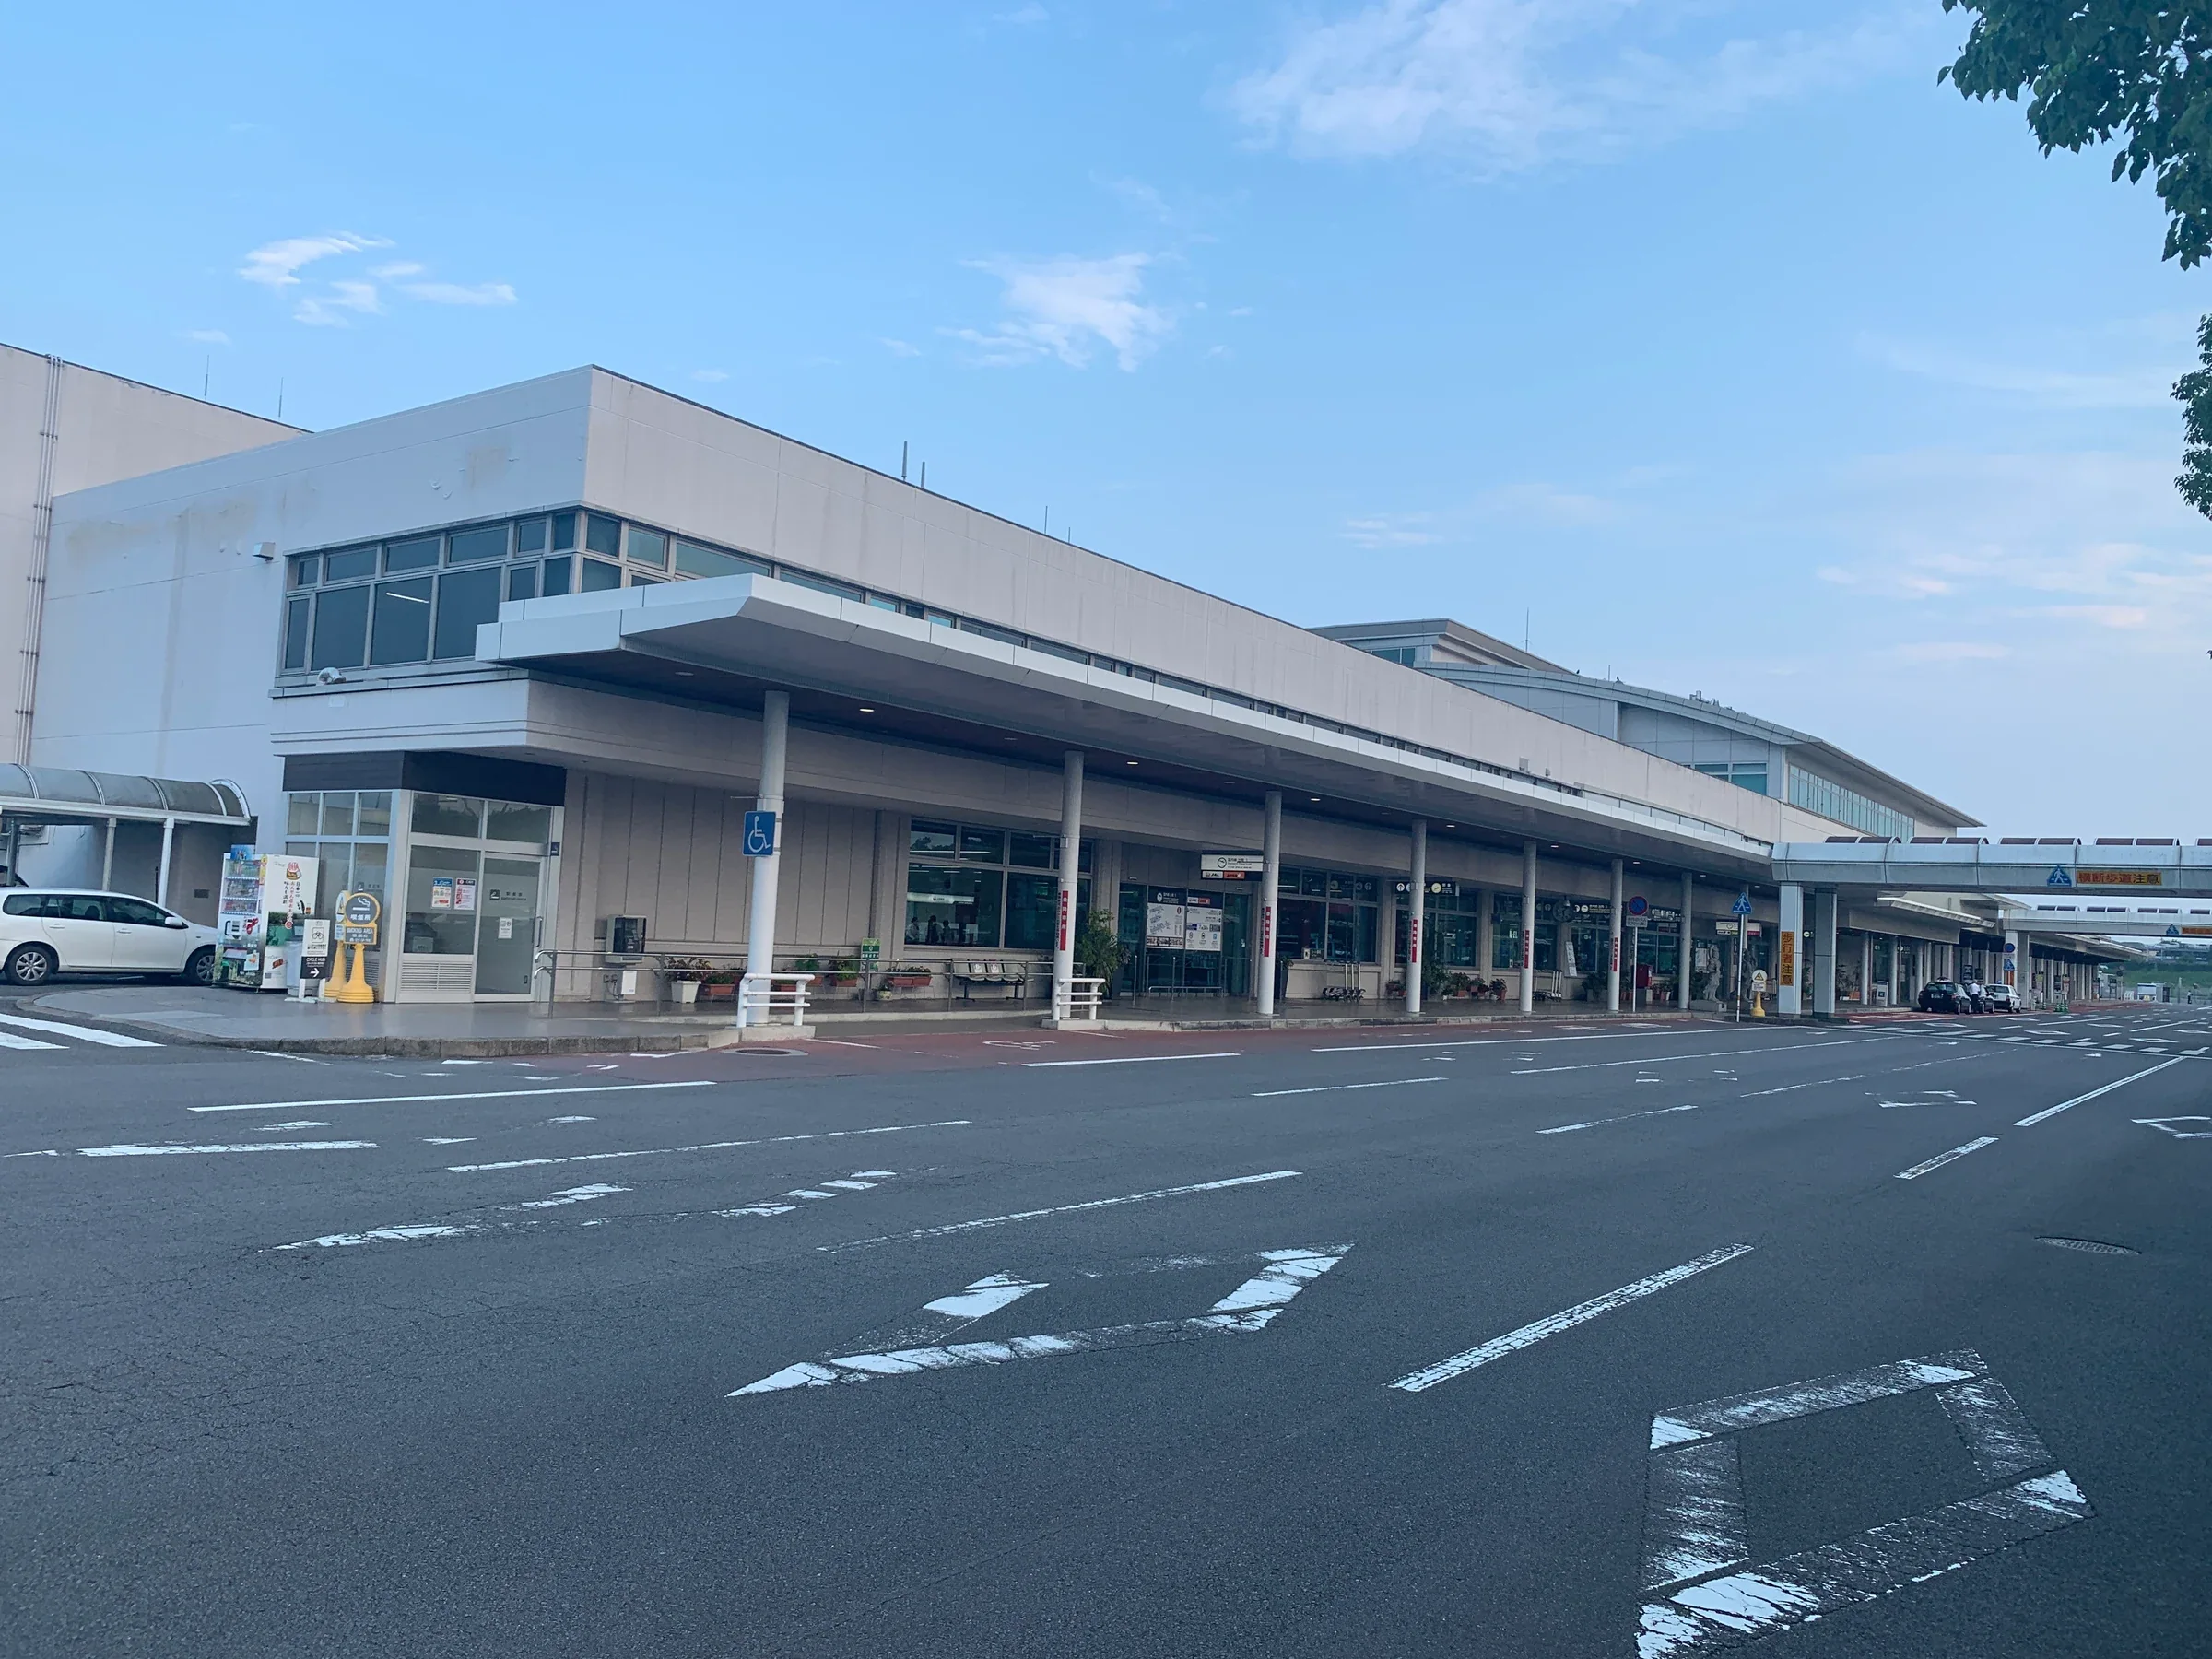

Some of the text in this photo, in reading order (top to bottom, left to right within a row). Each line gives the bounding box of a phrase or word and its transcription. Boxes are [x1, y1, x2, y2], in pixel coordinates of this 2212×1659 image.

[2078, 873, 2159, 885] 横断歩道注意
[1781, 933, 1793, 984] 歩行者注意
